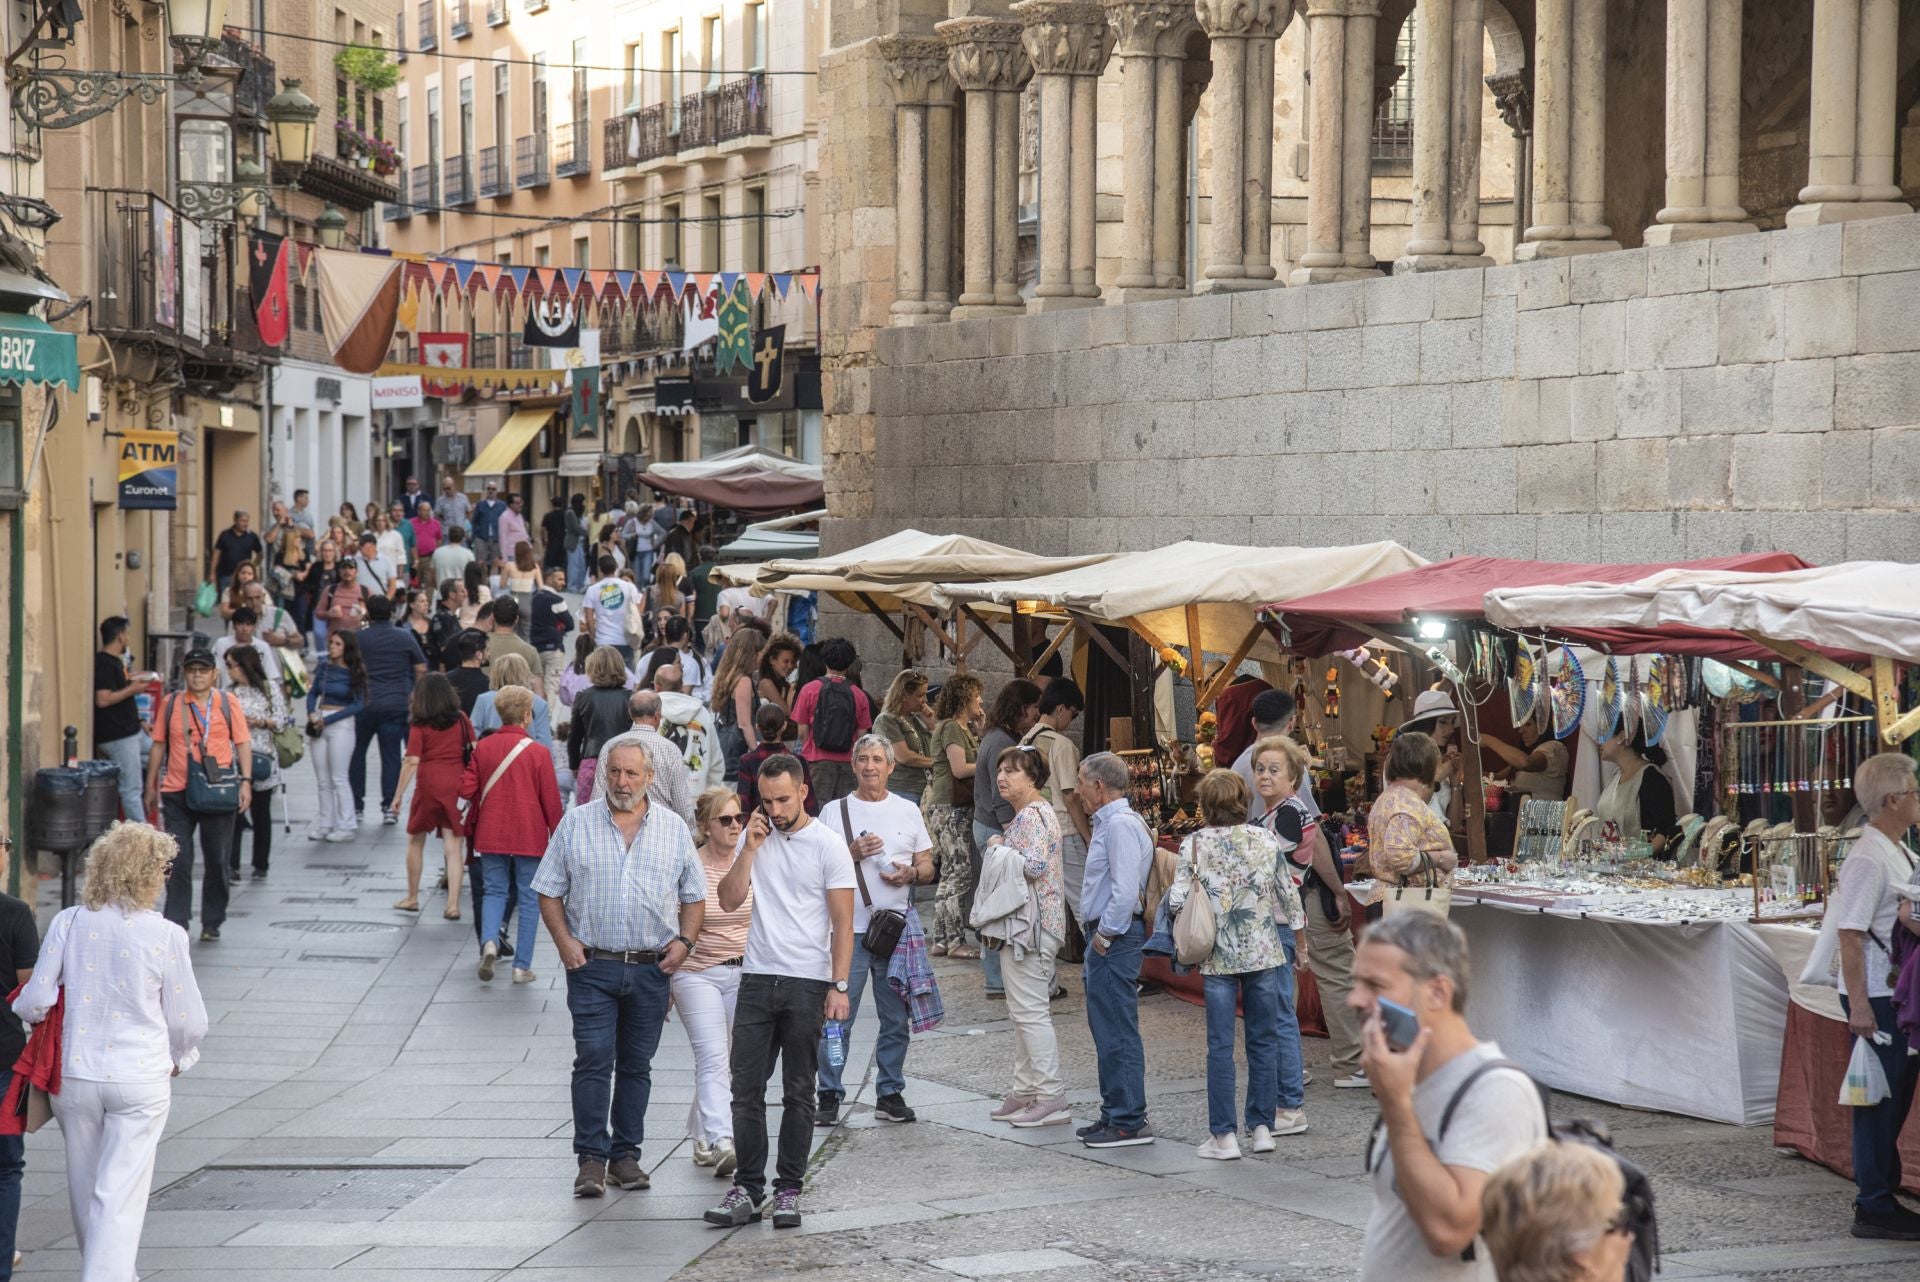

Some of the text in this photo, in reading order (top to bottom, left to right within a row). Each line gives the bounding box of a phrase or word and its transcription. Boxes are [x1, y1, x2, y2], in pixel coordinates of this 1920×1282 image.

[375, 386, 418, 398] MINISO
[121, 442, 175, 462] ATM
[125, 484, 169, 496] Euronet
